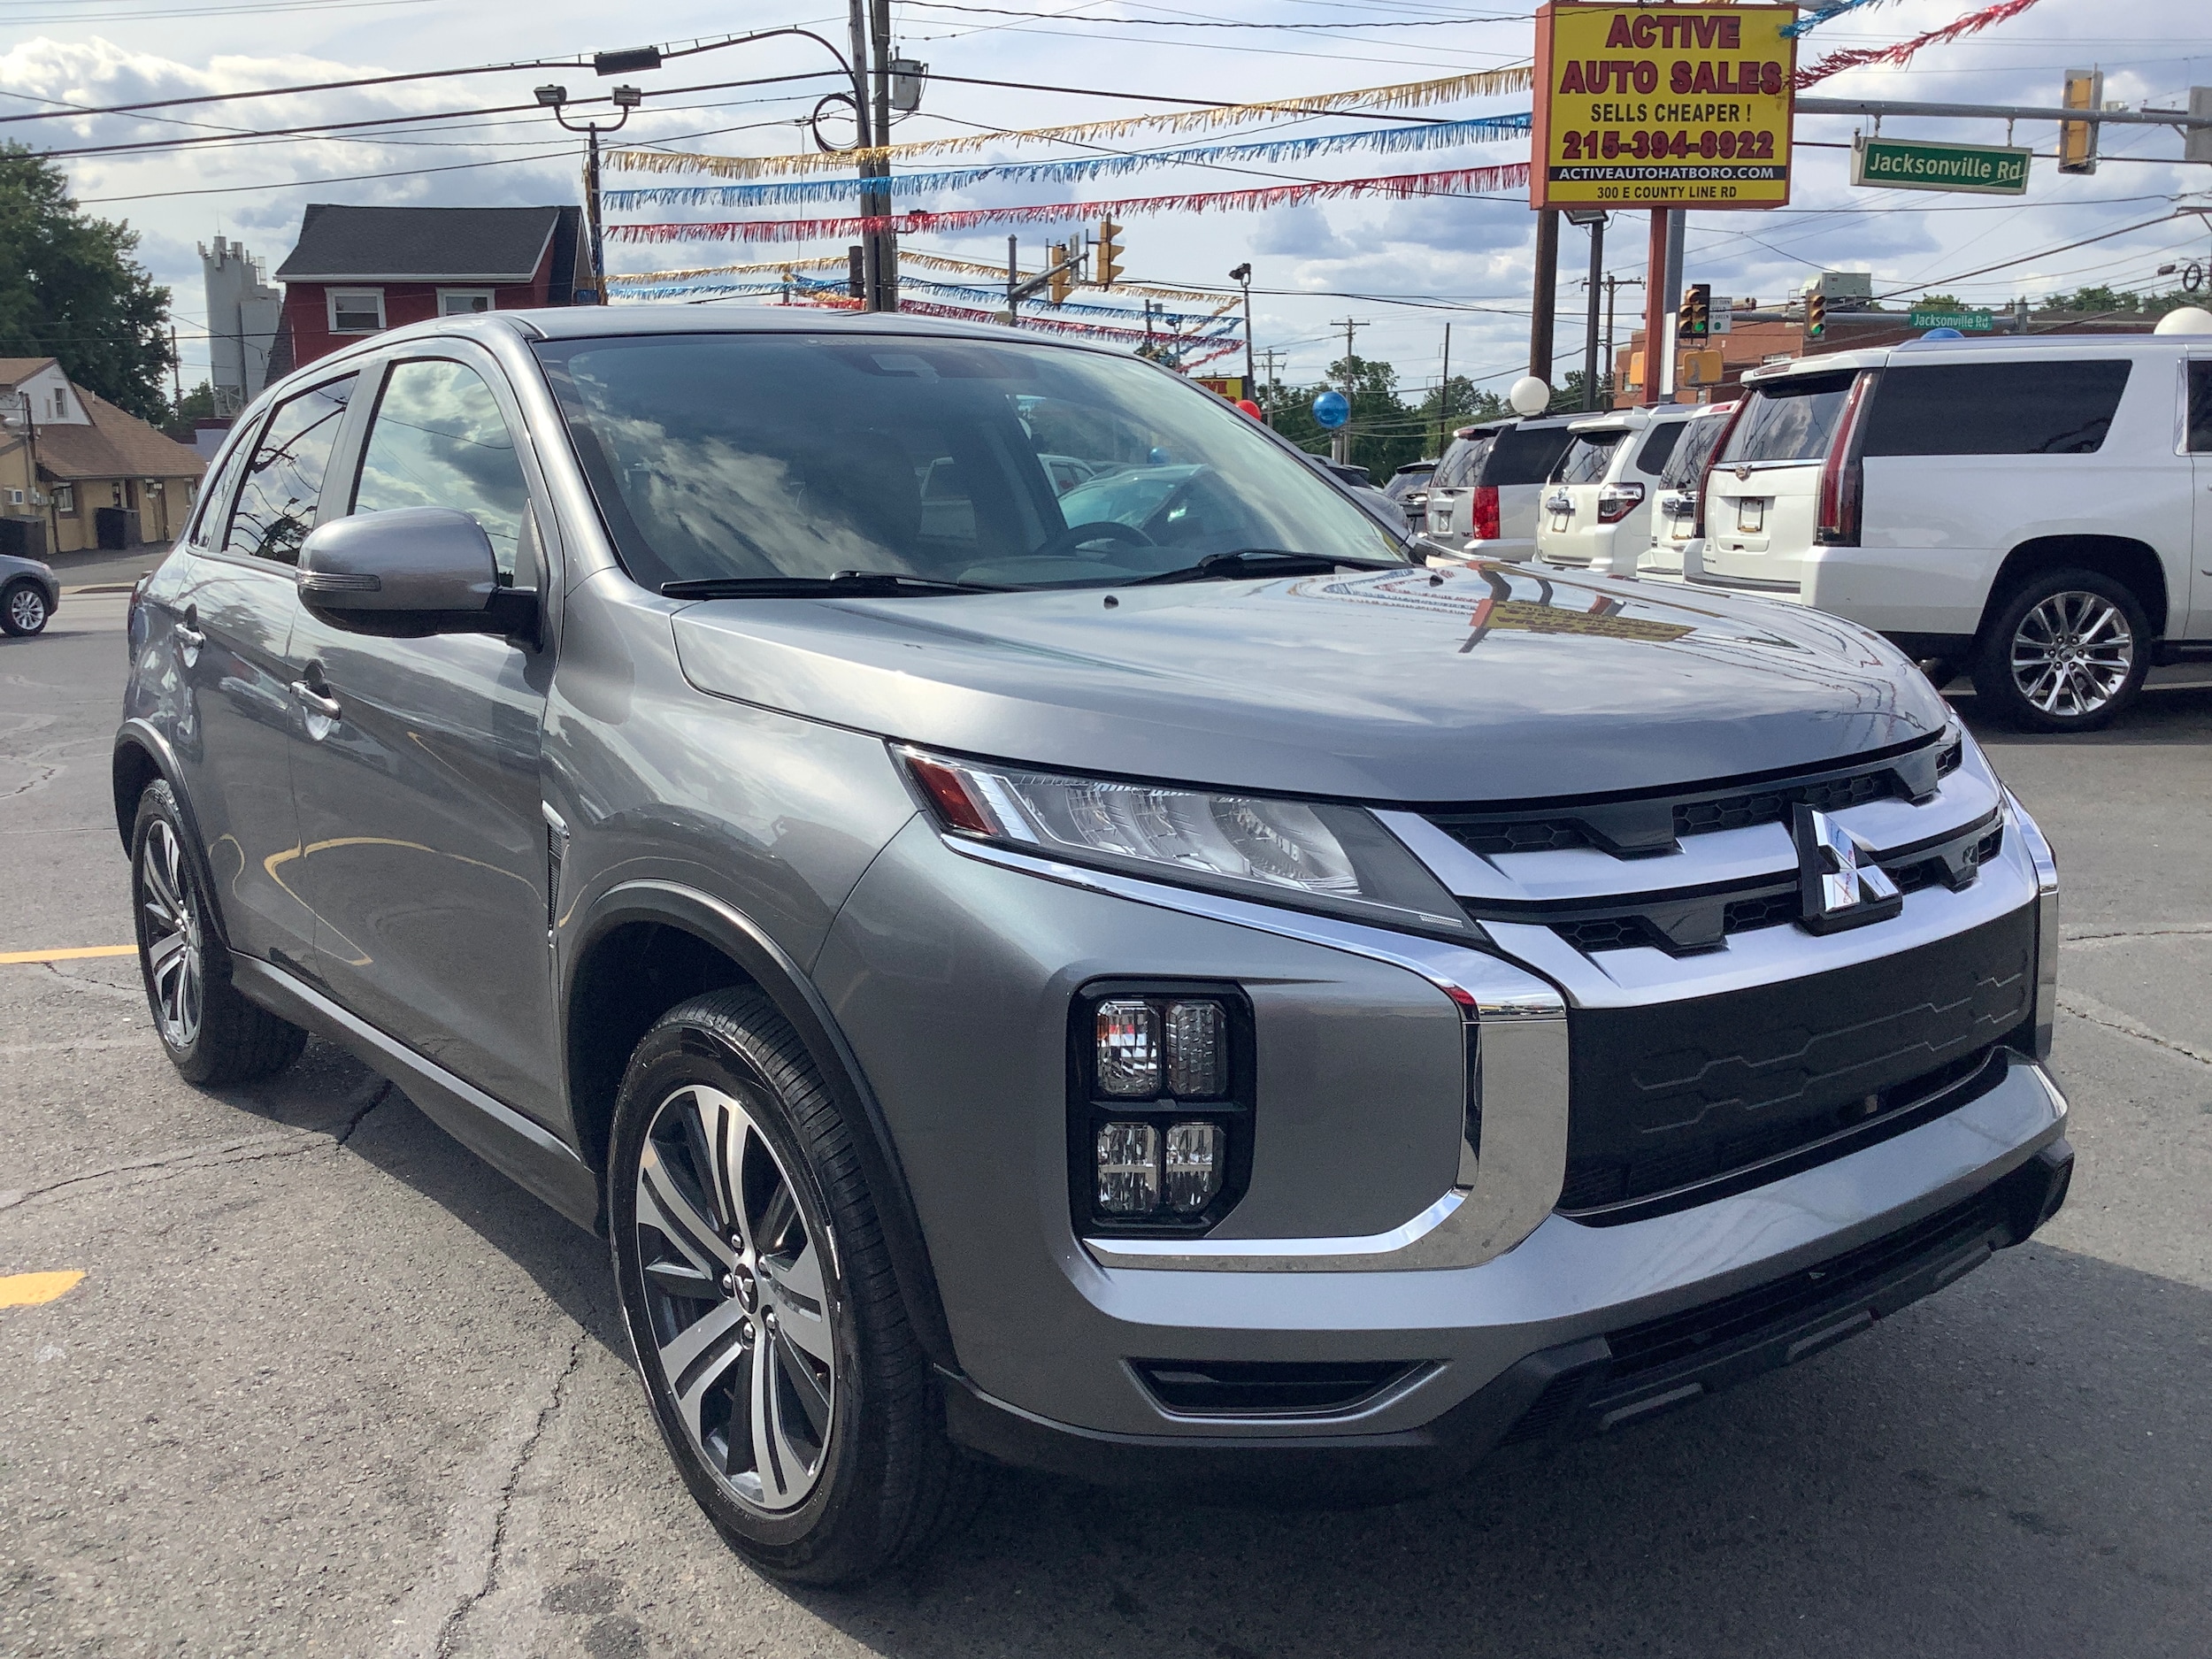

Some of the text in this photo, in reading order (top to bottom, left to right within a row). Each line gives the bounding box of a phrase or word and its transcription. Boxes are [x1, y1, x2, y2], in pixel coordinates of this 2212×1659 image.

[1605, 14, 1741, 49] ACTIVE
[1559, 60, 1782, 95] AUTO SALES
[1591, 104, 1647, 122] SELLS
[1655, 104, 1740, 122] CHEAPER
[1562, 130, 1774, 159] 215-394-8922
[1558, 166, 1774, 180] ACTIVEAUTOHATBORO.COM
[1870, 152, 2022, 180] Jacksonville Rd
[1597, 186, 1737, 199] 300 E COUNTY LINE RD
[1914, 314, 1988, 328] Jacksonville Rd
